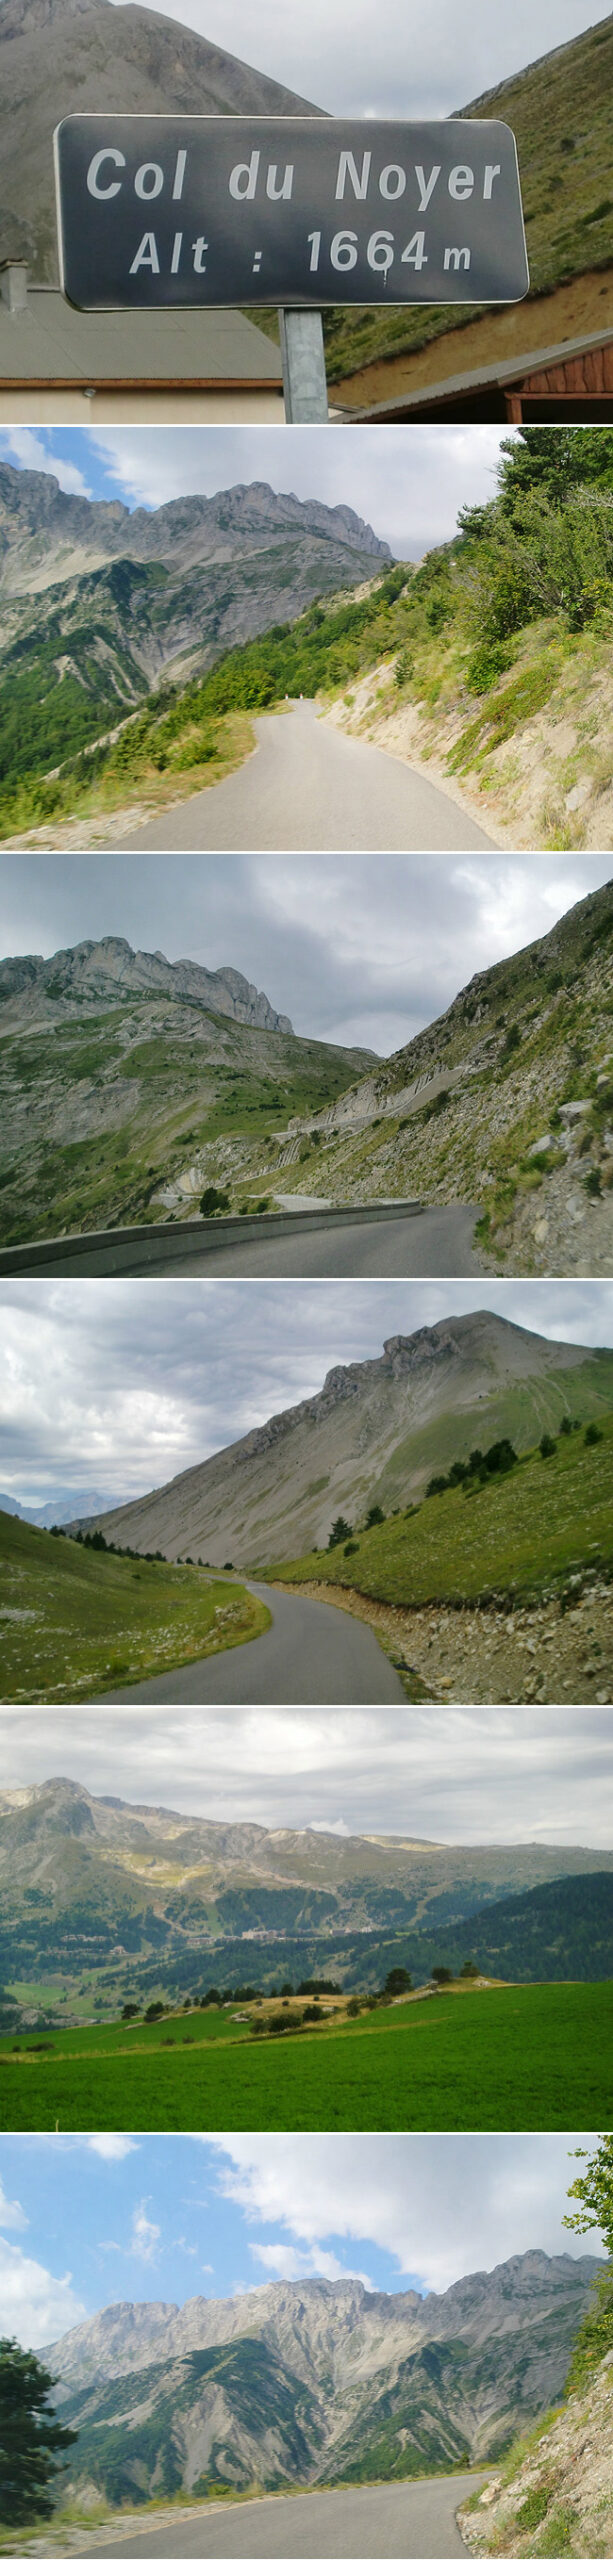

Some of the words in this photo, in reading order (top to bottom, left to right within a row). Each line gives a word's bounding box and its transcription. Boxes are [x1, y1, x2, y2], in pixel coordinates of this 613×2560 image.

[86, 148, 188, 200] Col
[228, 151, 295, 200] du
[334, 151, 501, 212] Noyer
[129, 232, 209, 274] Alt
[307, 231, 429, 272] 1664
[443, 247, 471, 270] m
